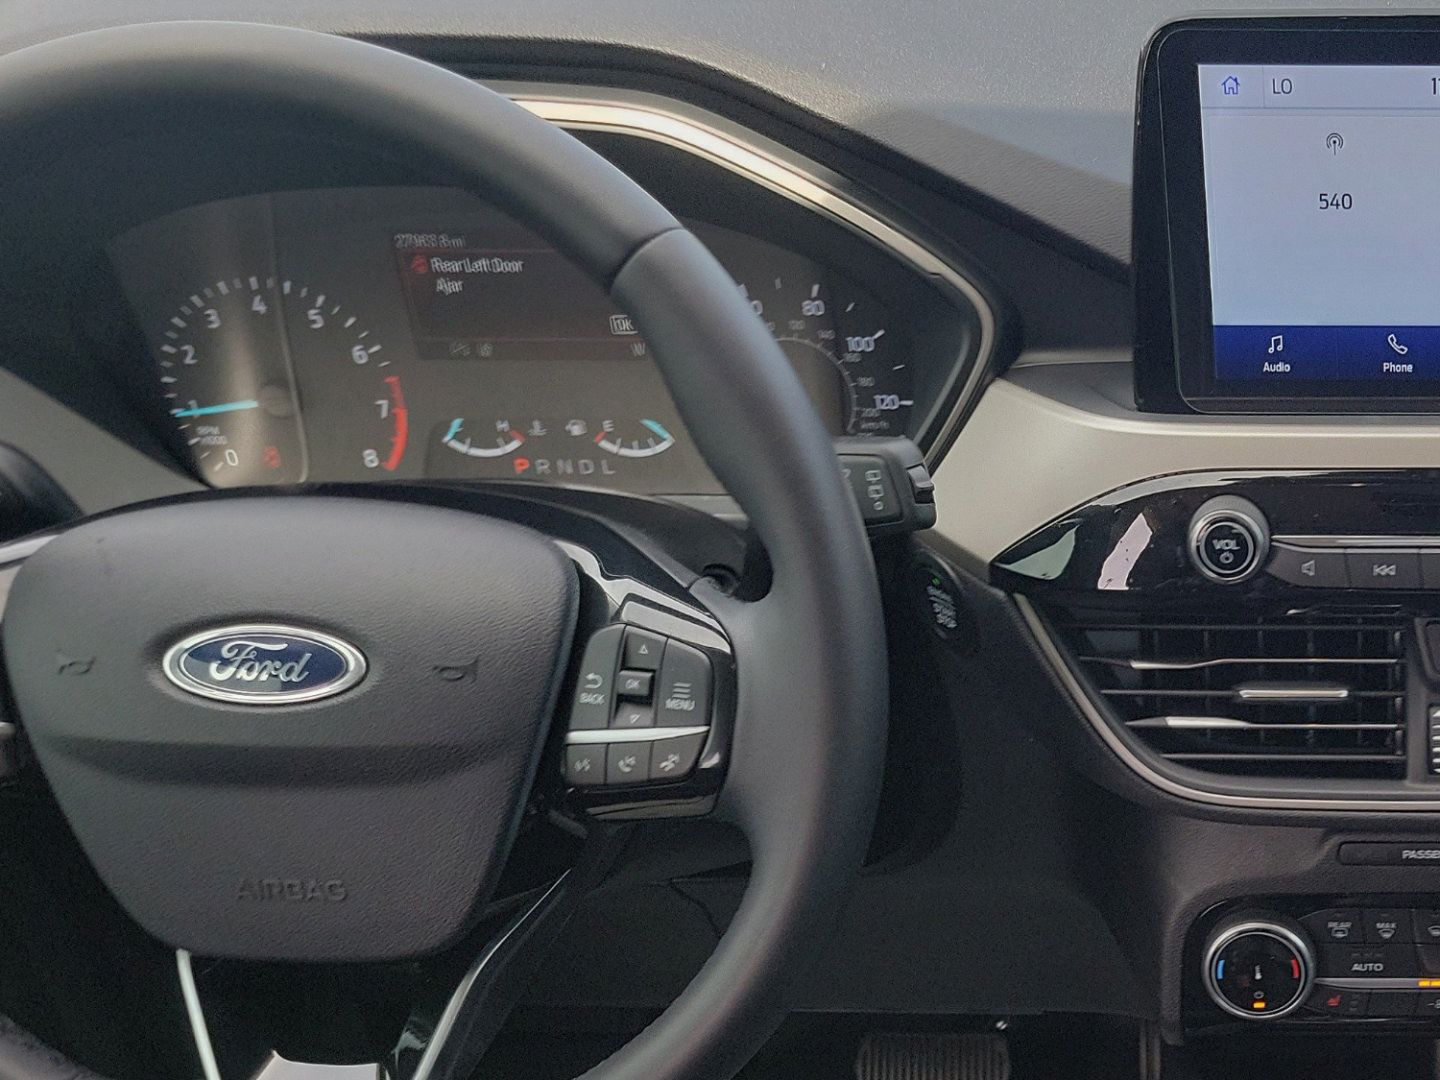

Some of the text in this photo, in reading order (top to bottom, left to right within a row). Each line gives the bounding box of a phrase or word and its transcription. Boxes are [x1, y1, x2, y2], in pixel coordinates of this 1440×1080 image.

[1272, 78, 1293, 96] LO
[1318, 193, 1353, 211] 540
[430, 257, 524, 273] Rear Left Door
[436, 277, 464, 295] Ajar
[252, 296, 267, 314] 4
[205, 310, 221, 329] 3
[308, 310, 324, 329] 5
[846, 336, 875, 352] 100
[184, 345, 198, 365] 2
[352, 345, 369, 364] 6
[1263, 362, 1291, 374] Audio
[1383, 362, 1413, 374] Phone
[375, 400, 389, 418] 7
[874, 394, 899, 410] 120
[603, 420, 615, 432] E
[225, 449, 239, 467] 0
[363, 449, 379, 468] 8
[1212, 539, 1240, 550] VOL
[208, 640, 312, 683] Ford
[665, 698, 695, 711] MENU
[236, 877, 348, 902] AIRBAG
[1351, 962, 1384, 972] AUTO
